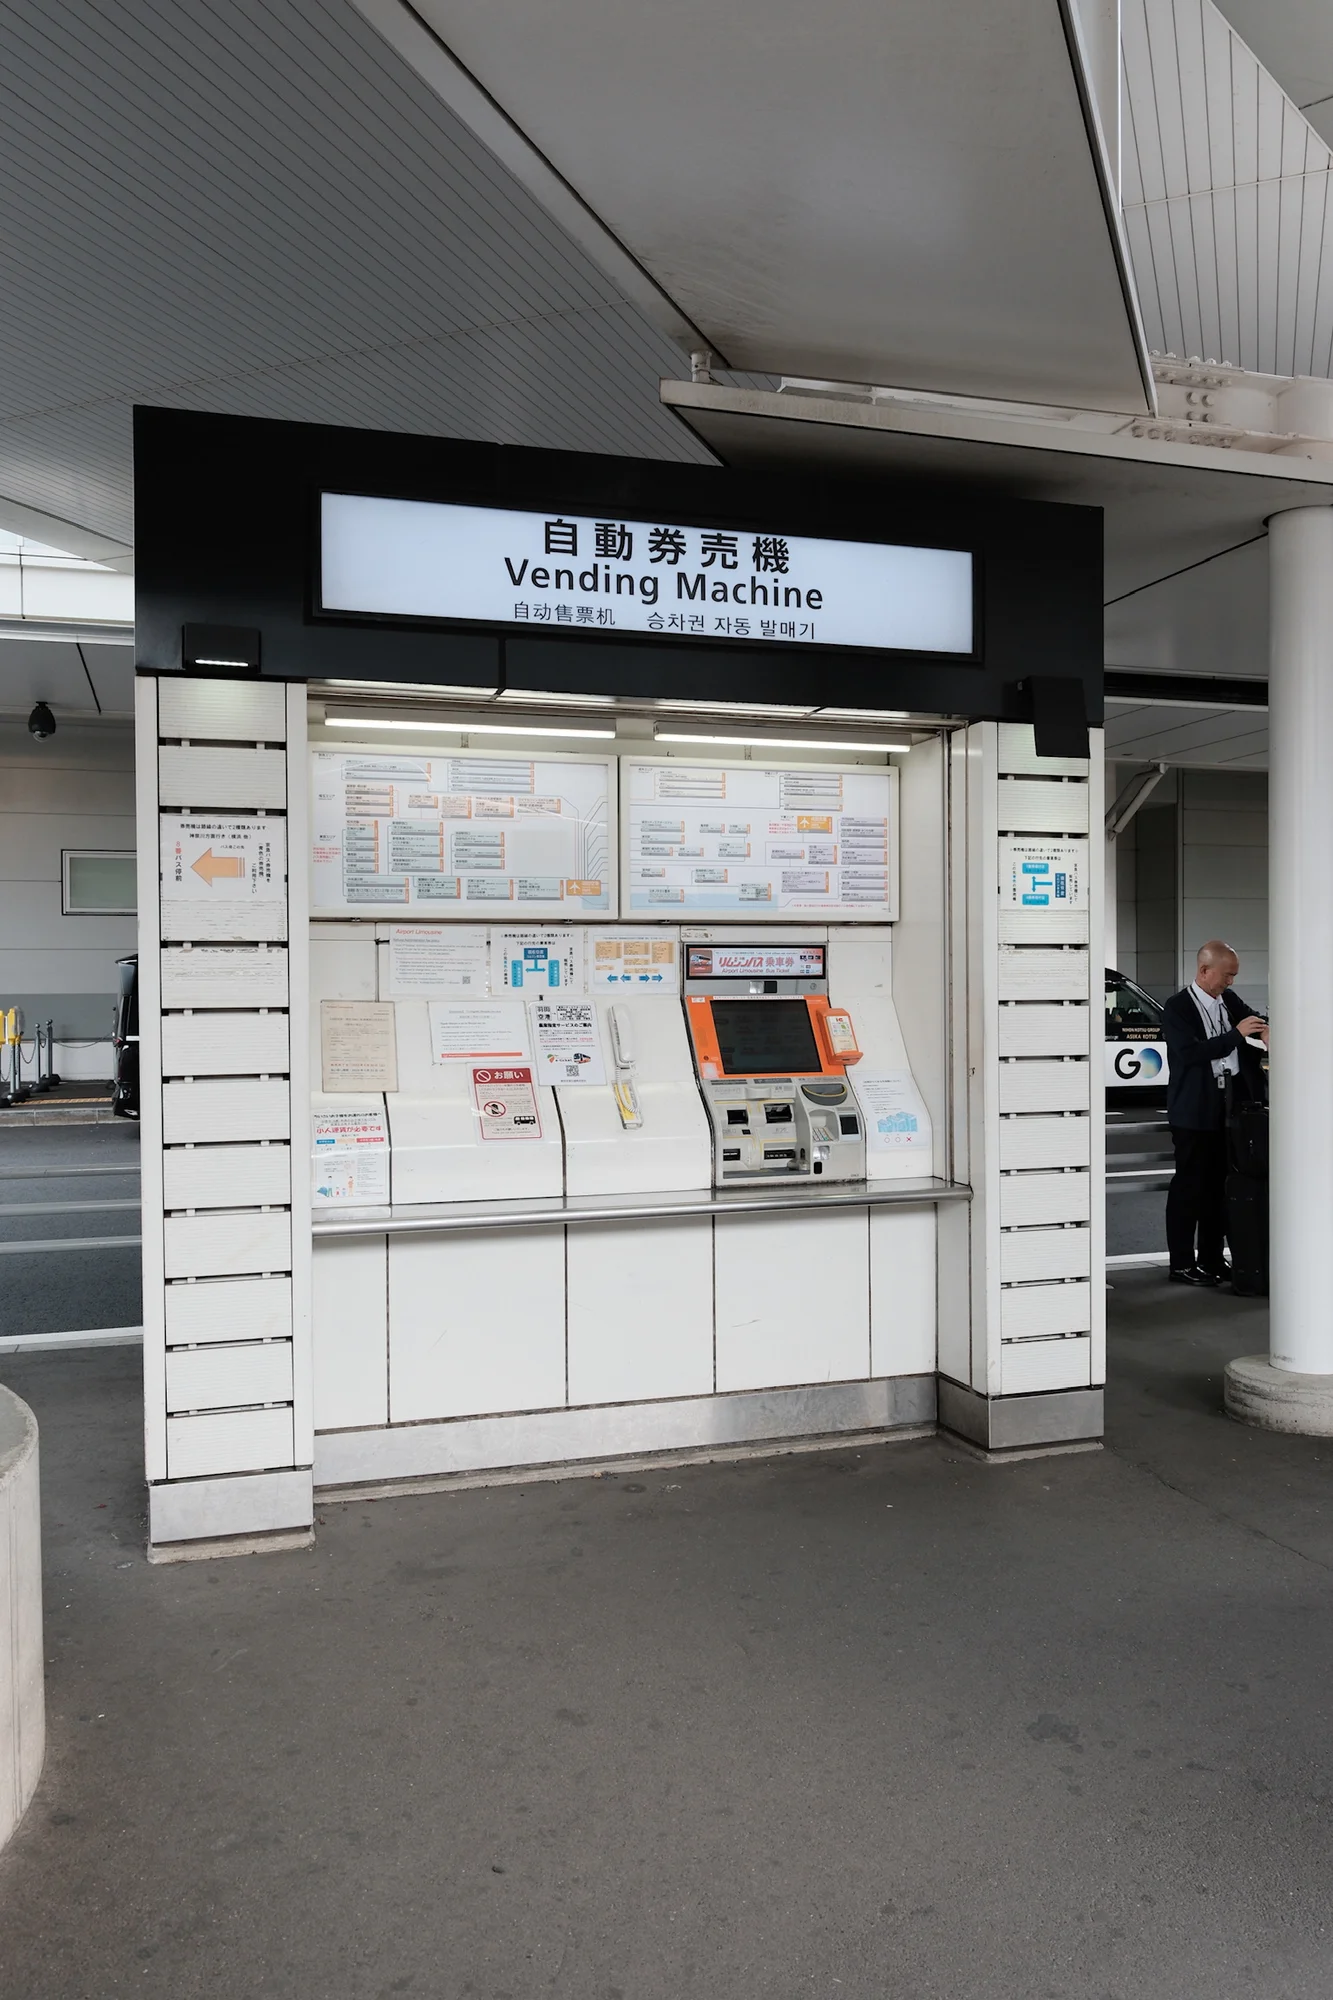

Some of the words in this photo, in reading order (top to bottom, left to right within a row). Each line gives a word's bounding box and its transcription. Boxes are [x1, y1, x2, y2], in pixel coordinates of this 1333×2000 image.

[544, 517, 790, 574] 自動券売機
[504, 556, 660, 605] Vending
[676, 570, 824, 610] Machine
[513, 601, 616, 627] 自动售票机
[647, 611, 706, 634] 승차권
[714, 614, 752, 636] 자동
[760, 617, 816, 640] 발매기
[494, 1071, 524, 1080] お願い
[1115, 1048, 1163, 1080] GO
